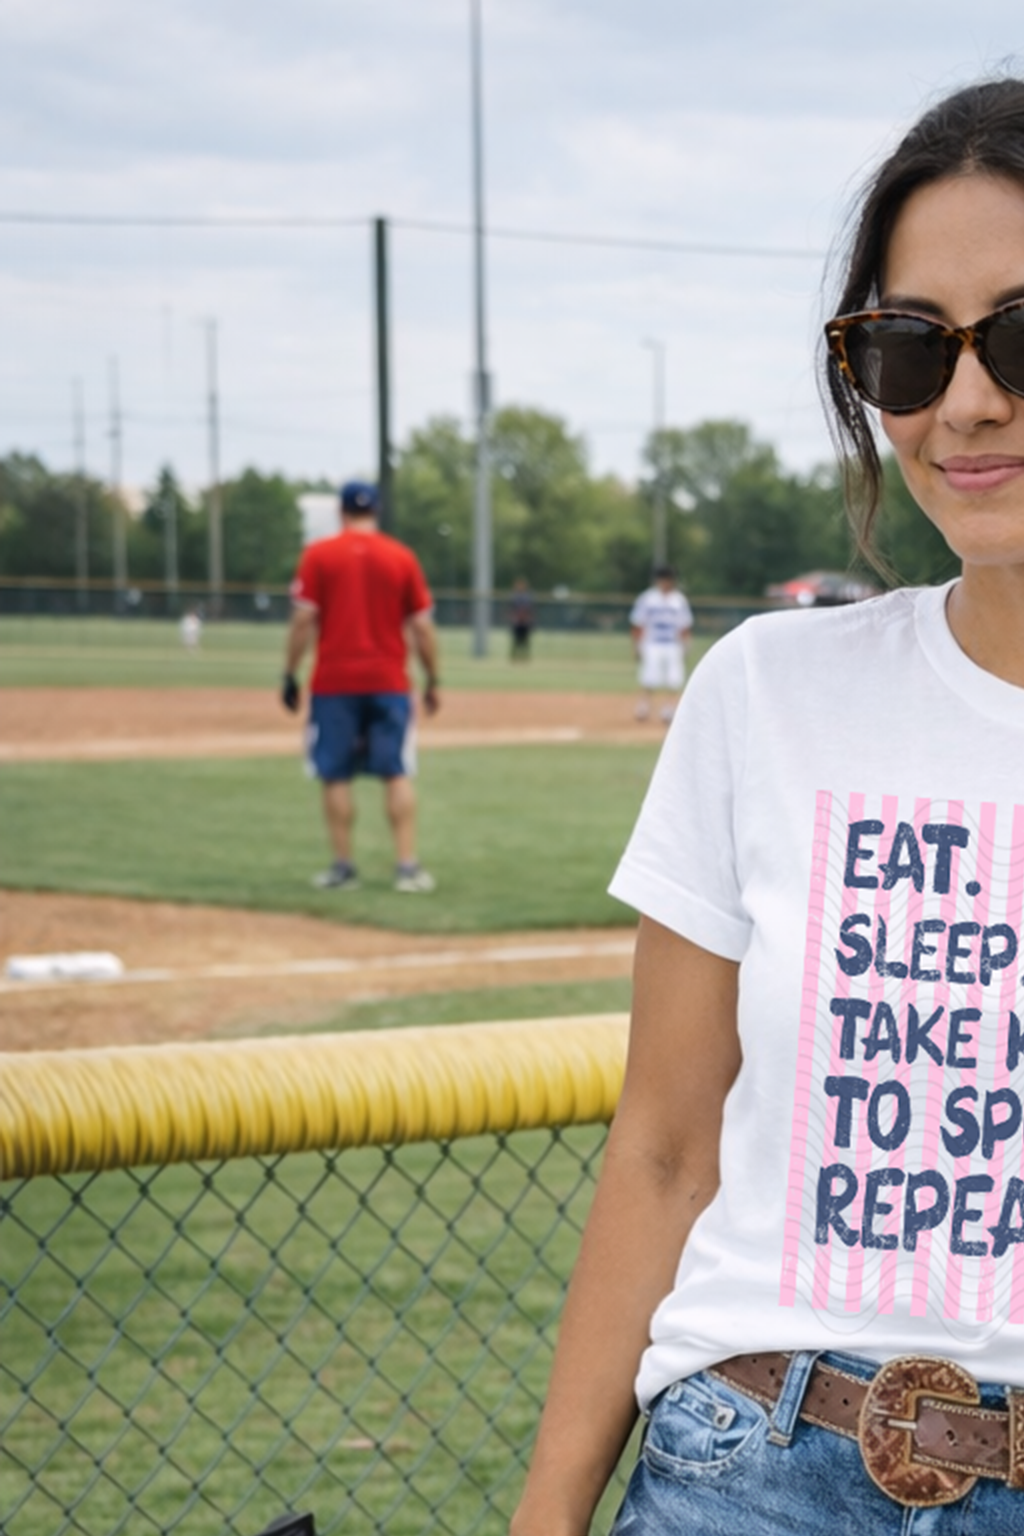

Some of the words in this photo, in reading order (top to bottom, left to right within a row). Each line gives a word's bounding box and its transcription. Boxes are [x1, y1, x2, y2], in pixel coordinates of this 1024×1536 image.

[843, 819, 982, 897] EAT.
[829, 997, 982, 1068] TAKE
[824, 1075, 911, 1151] TO
